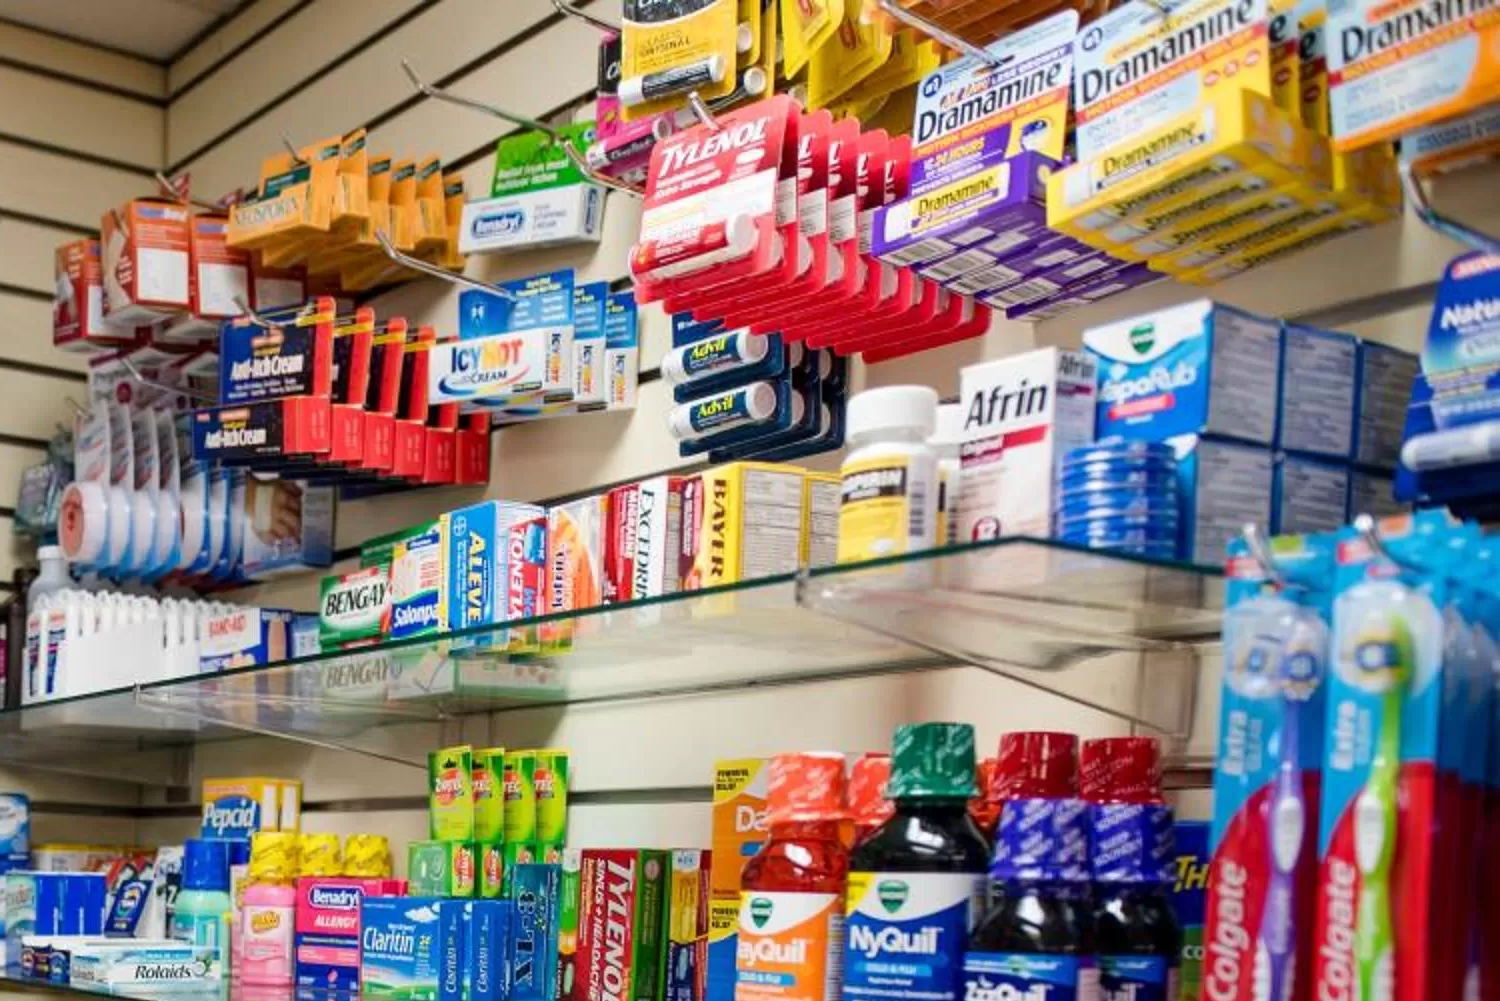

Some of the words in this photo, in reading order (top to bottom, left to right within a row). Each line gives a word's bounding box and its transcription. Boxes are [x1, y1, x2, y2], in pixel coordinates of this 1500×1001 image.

[1081, 0, 1250, 104] Dramamine
[918, 62, 1062, 144] Dramamine
[657, 116, 768, 178] TYLENOL
[918, 175, 994, 216] Dramamine
[690, 337, 727, 362] Advil
[699, 395, 734, 418] Advil
[964, 378, 1047, 431] Afrin
[710, 478, 728, 577] BAYER
[466, 531, 486, 623] ALEVE
[507, 525, 525, 622] YLENOL
[325, 581, 390, 617] BENGAY
[393, 601, 439, 628] Salonpa
[201, 799, 257, 838] Pepcid
[313, 889, 359, 905] Benadryl
[315, 914, 357, 928] ALLERGY
[363, 926, 415, 954] Claritin
[737, 938, 805, 967] ayQuil
[850, 924, 938, 959] NyQuil
[135, 963, 193, 981] Rolaids
[445, 947, 458, 993] Claritin
[477, 947, 490, 993] Claritin
